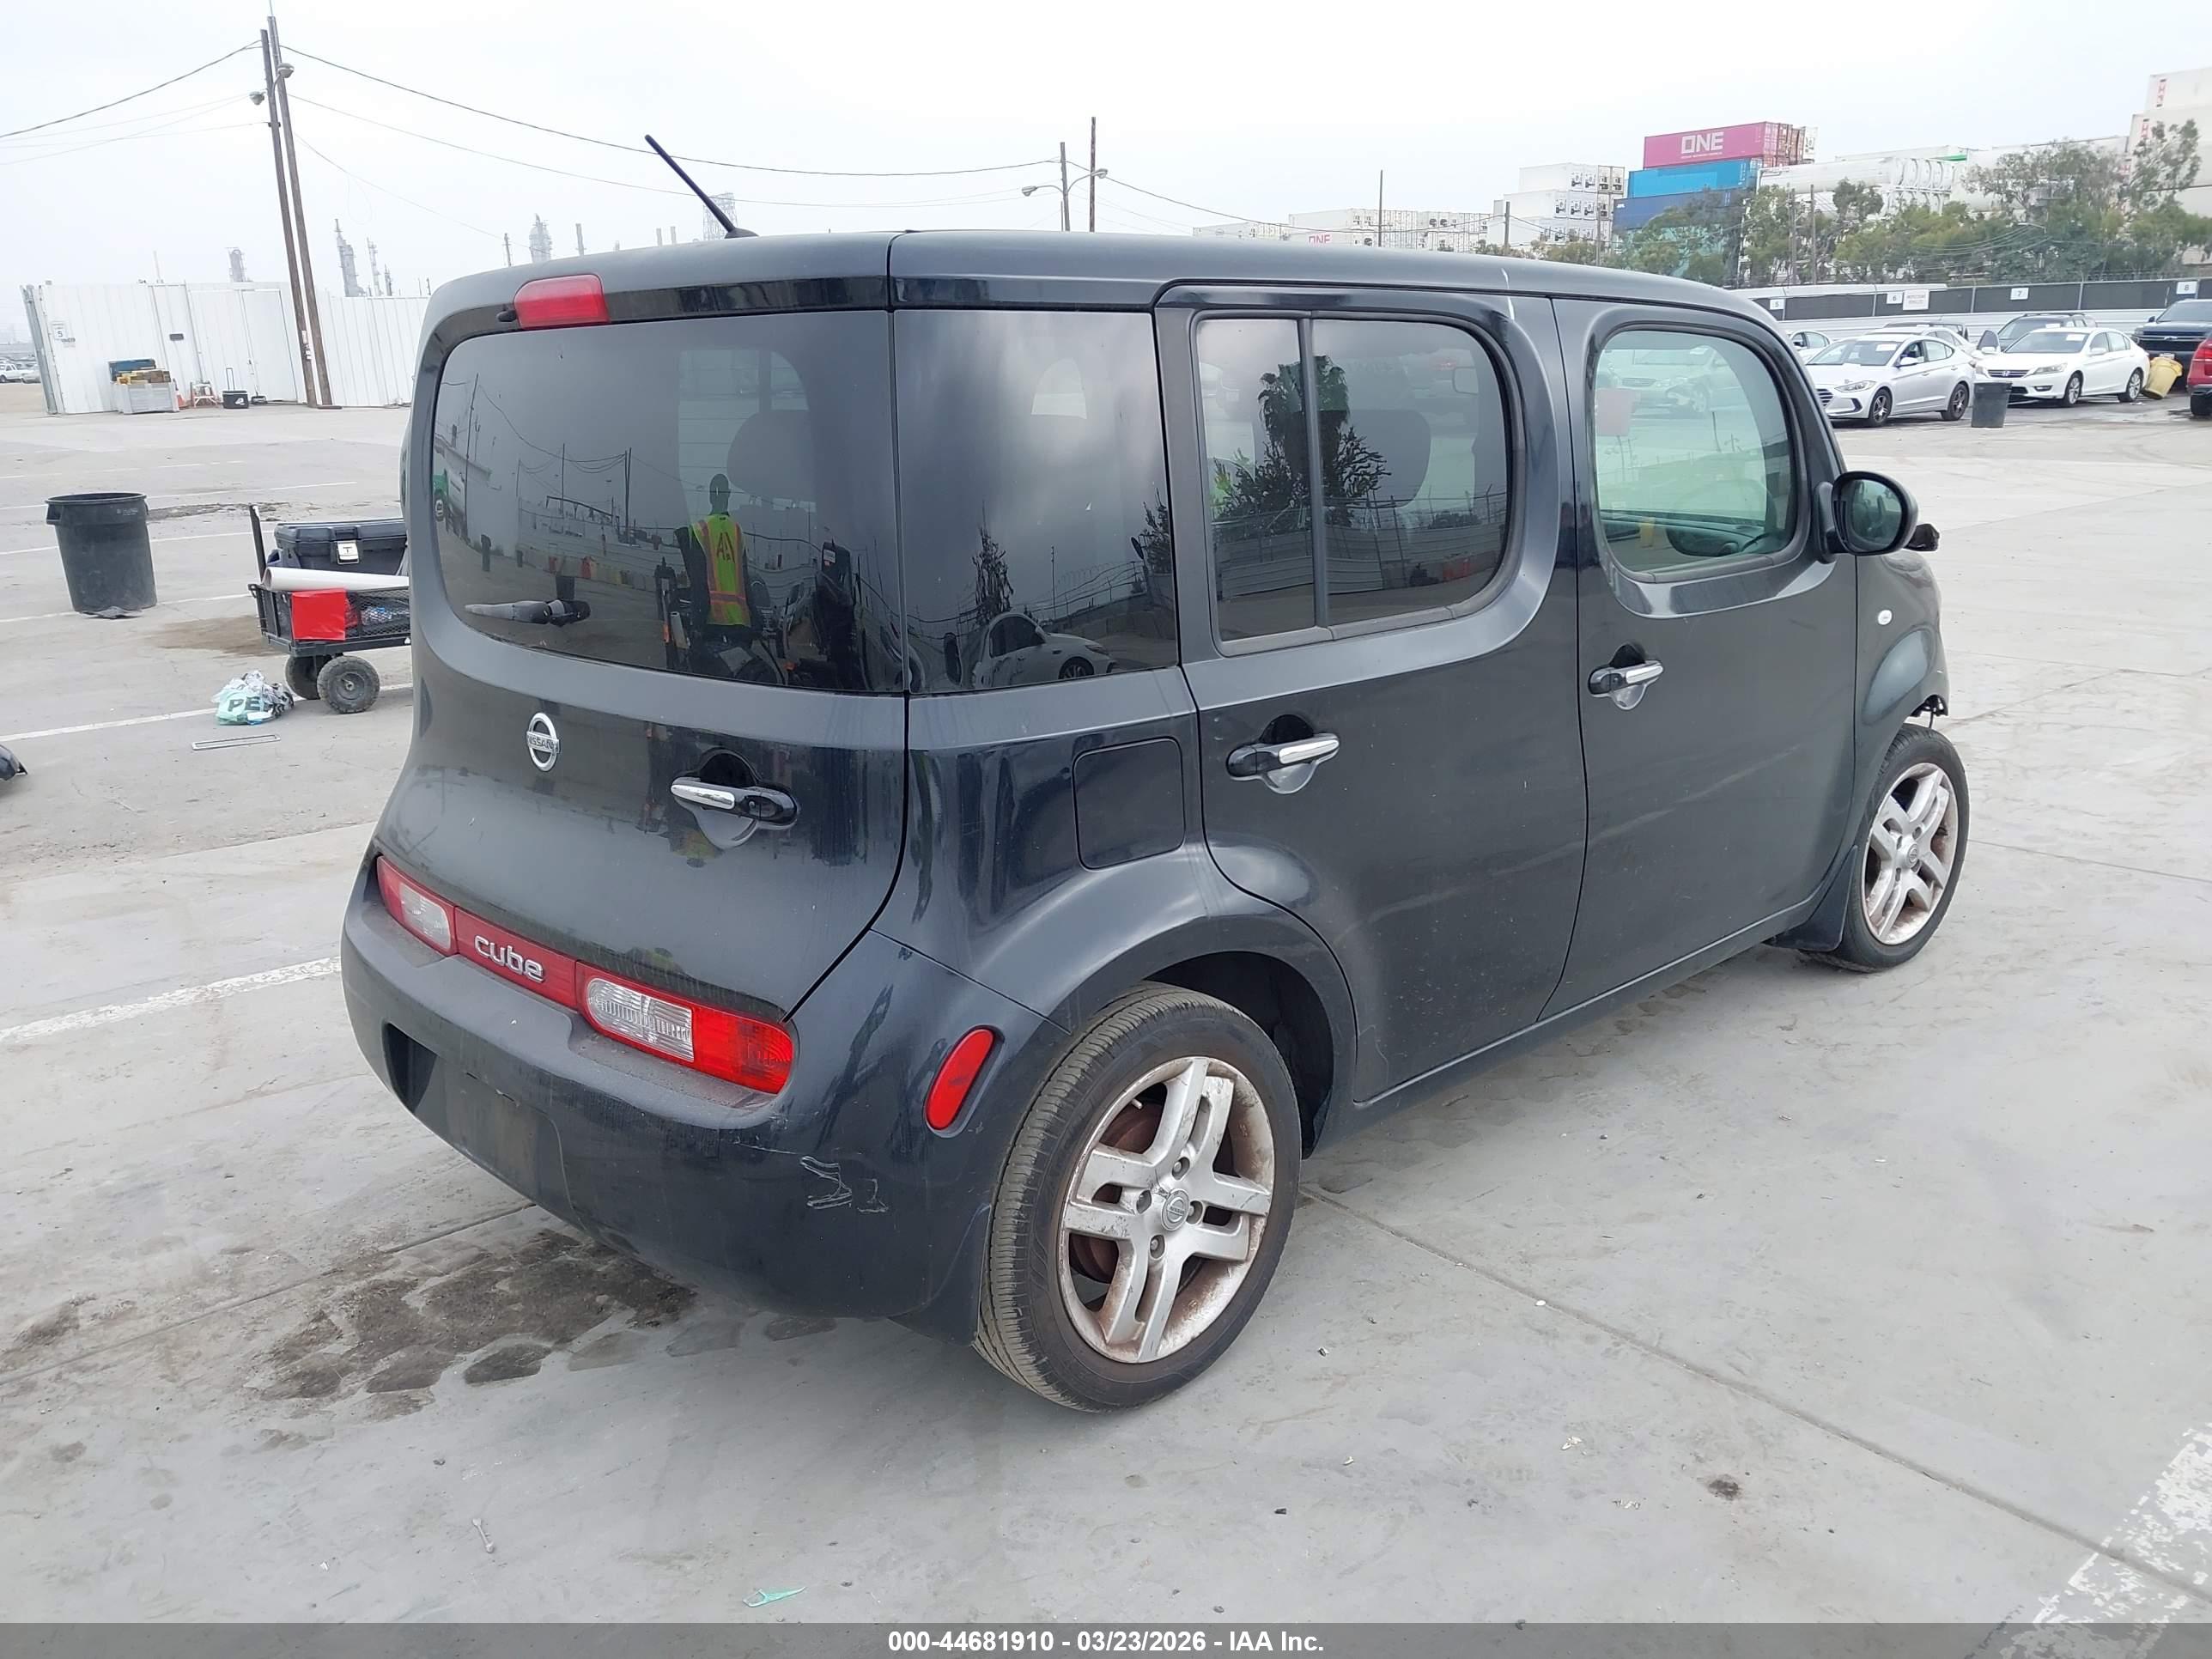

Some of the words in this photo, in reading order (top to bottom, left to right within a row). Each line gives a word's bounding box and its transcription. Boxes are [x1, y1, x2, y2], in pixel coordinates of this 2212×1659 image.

[1681, 131, 1724, 154] ONE
[527, 735, 557, 752] NISSAN
[475, 935, 544, 983] cube
